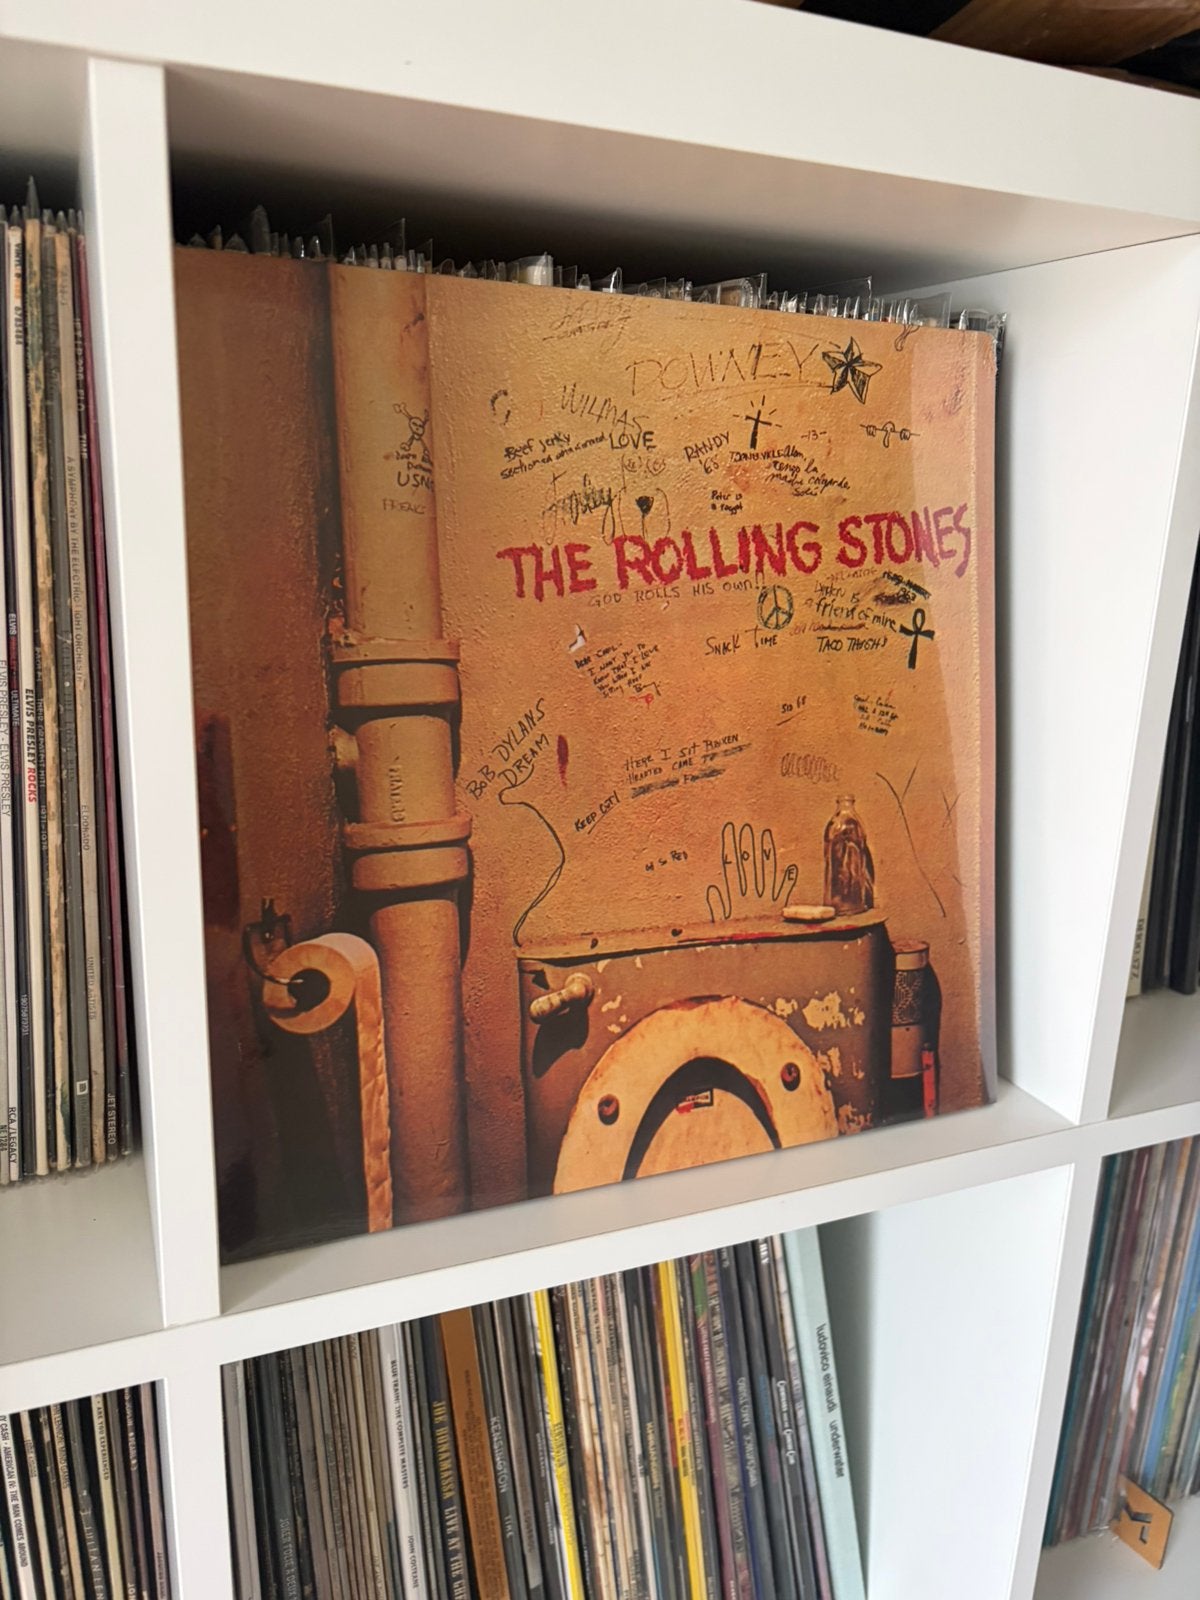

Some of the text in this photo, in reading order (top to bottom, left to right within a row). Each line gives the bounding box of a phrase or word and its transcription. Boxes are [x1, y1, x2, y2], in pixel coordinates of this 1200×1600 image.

[609, 430, 657, 451] LOVE
[685, 431, 730, 460] RANDY
[496, 543, 597, 602] THE
[613, 521, 822, 590] ROLLING
[836, 503, 971, 577] STONES
[692, 583, 715, 597] HIS
[9, 613, 17, 636] ELVIS
[815, 596, 857, 620] friend
[871, 611, 897, 633] mine
[817, 636, 843, 653] TACO
[11, 690, 20, 727] ULTIMATE
[494, 697, 545, 763] DYLANS
[1, 743, 9, 767] ELVIS
[25, 688, 37, 803] ELVIS PRESLEY ROCKS
[498, 734, 549, 788] DREAM
[2, 768, 11, 817] PRESLEY
[574, 811, 597, 833] KEEP
[107, 1093, 116, 1145] JET STEREO
[96, 1406, 104, 1419] ARE
[433, 1401, 447, 1425] JOE
[816, 1324, 845, 1478] ludovico einaudi underwater
[396, 1419, 406, 1456] COMPLETE
[3, 1445, 15, 1479] AMERICAN
[435, 1425, 455, 1500] BONAMASSA
[490, 1417, 506, 1494] KENSINGTON
[400, 1456, 409, 1489] MASTERS
[8, 1488, 18, 1502] THE
[10, 1502, 20, 1518] MAN
[12, 1518, 25, 1542] COMES
[444, 1505, 460, 1535] LIVE
[16, 1541, 28, 1568] AROUND
[449, 1536, 460, 1552] AT
[407, 1535, 420, 1589] JOHN COLTRANE
[450, 1553, 464, 1576] THE
